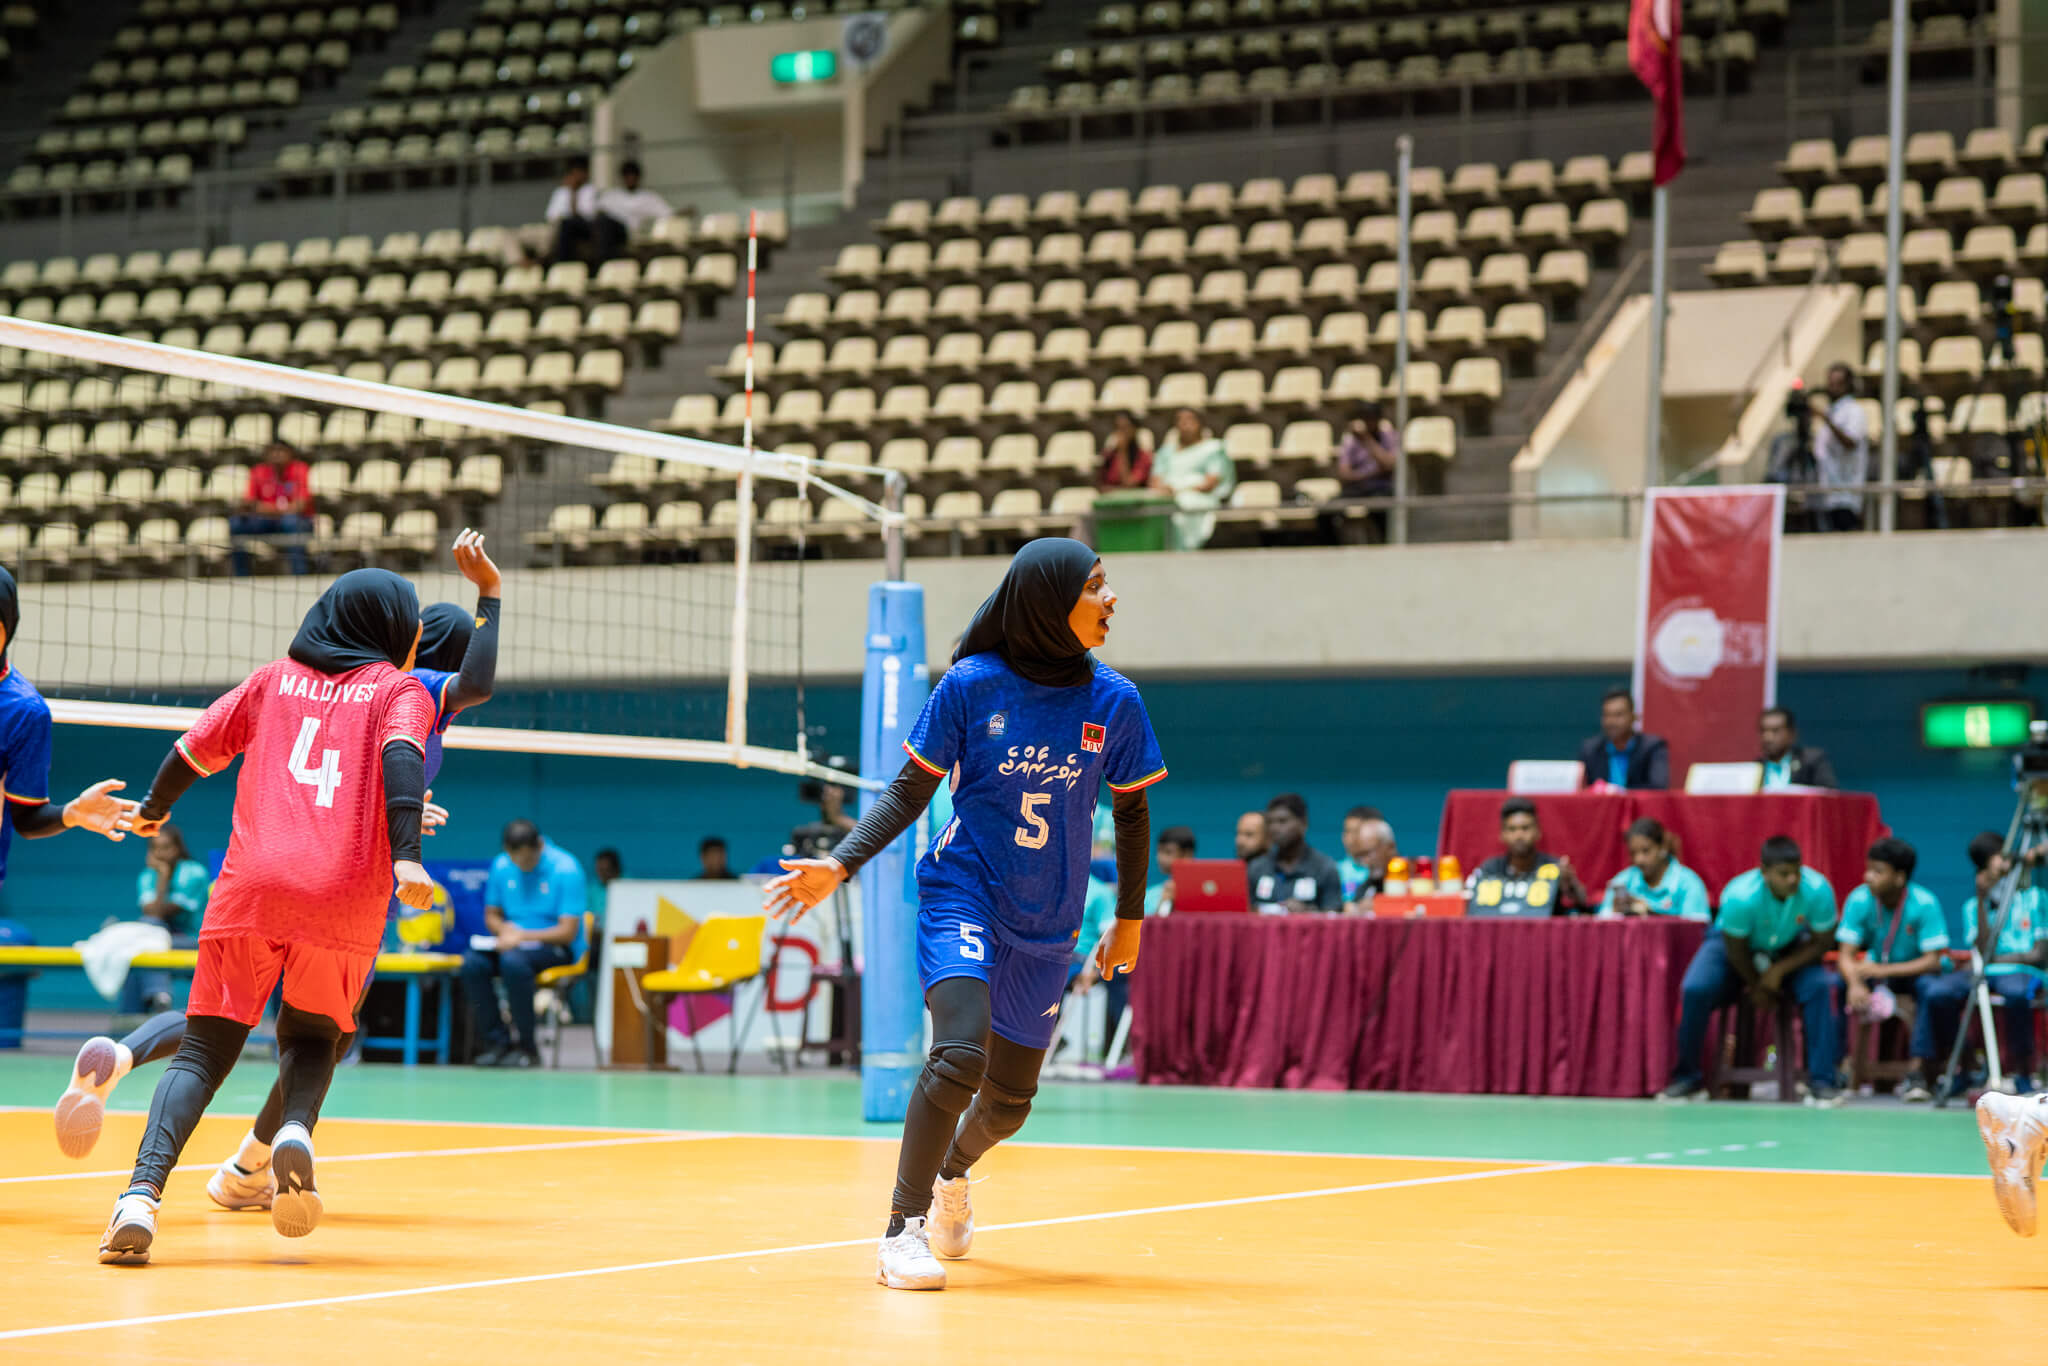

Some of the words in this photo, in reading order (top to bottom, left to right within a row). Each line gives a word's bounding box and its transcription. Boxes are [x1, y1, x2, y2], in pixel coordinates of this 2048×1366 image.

[278, 674, 378, 703] MALDIVES
[287, 716, 342, 808] 4
[1082, 739, 1102, 752] MDV
[1014, 791, 1052, 850] 5
[960, 922, 984, 961] 5
